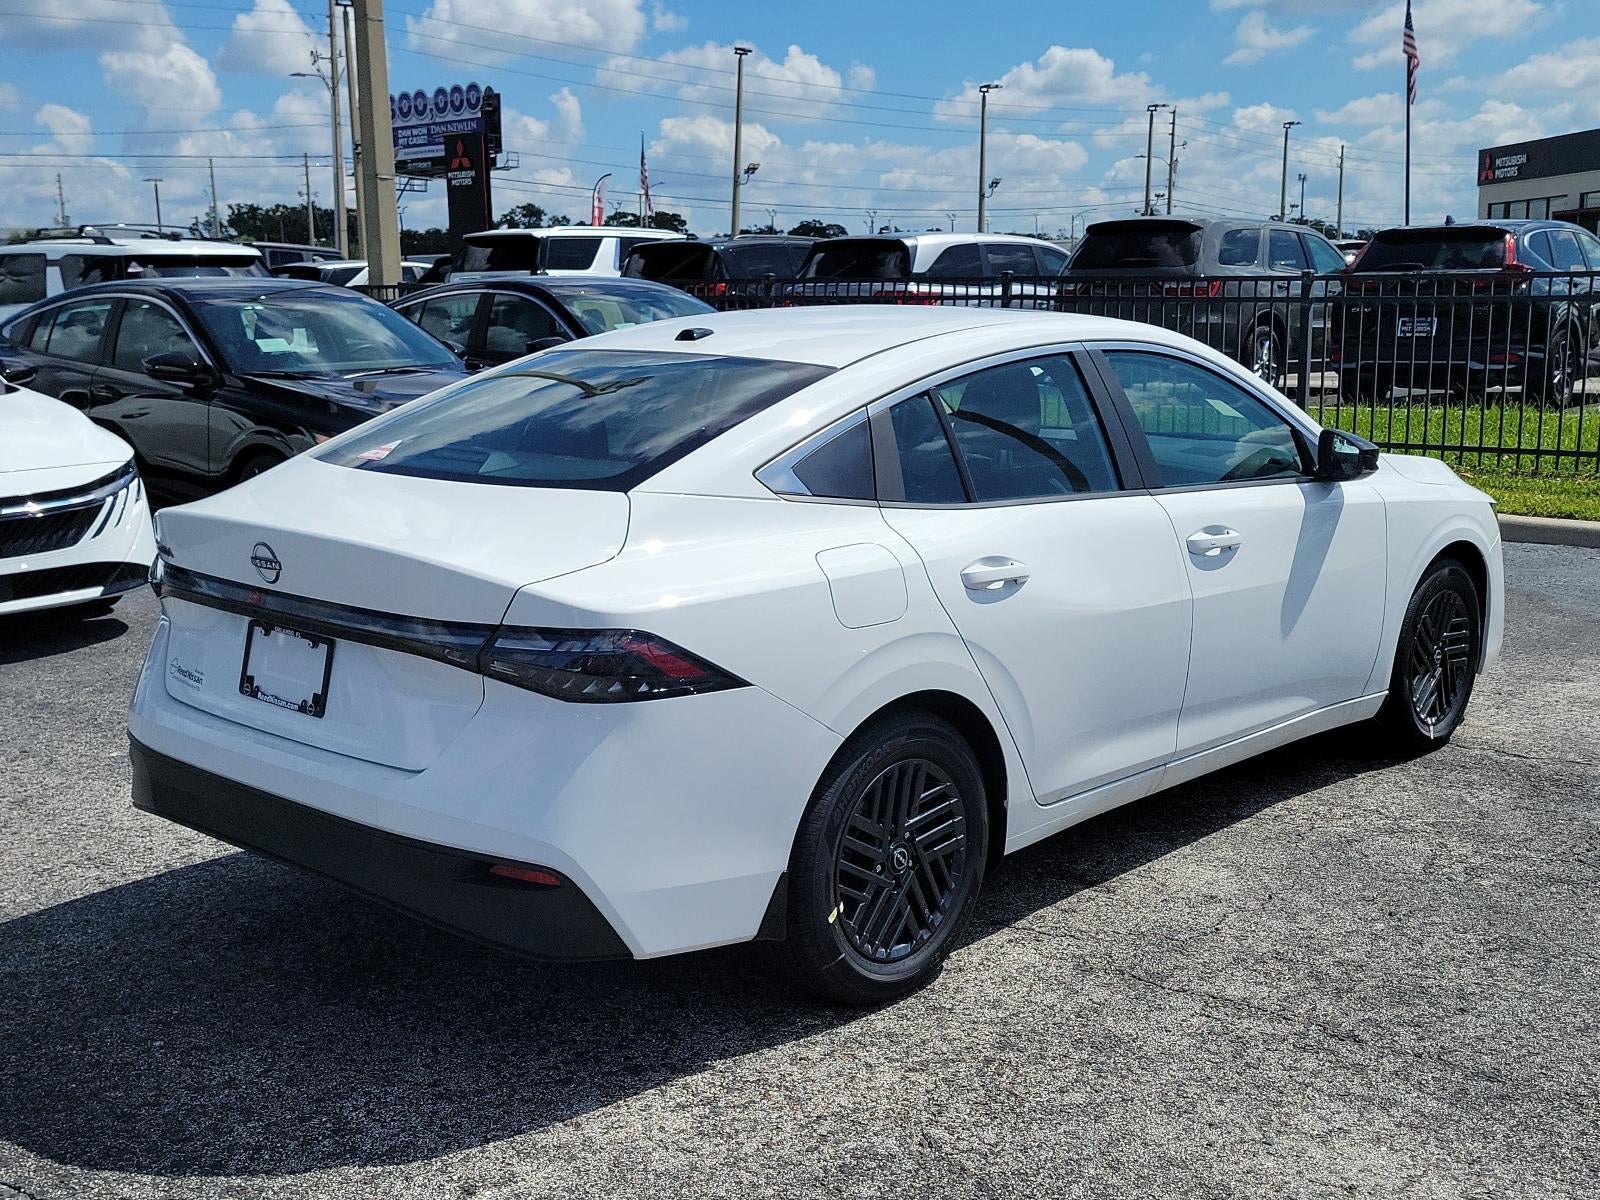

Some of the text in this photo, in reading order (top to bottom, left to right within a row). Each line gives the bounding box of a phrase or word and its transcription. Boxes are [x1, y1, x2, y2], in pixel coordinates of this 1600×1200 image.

[390, 82, 482, 121] 00,000
[412, 127, 428, 136] WON
[430, 120, 478, 134] DAN NEWLIN
[1495, 153, 1527, 168] MITSUBISHI
[448, 170, 475, 179] MITSUBISHI
[1494, 167, 1518, 179] MOTORS
[451, 178, 472, 186] MOTORS
[252, 558, 281, 570] NISSAN
[257, 692, 299, 711] ReedNissan.com
